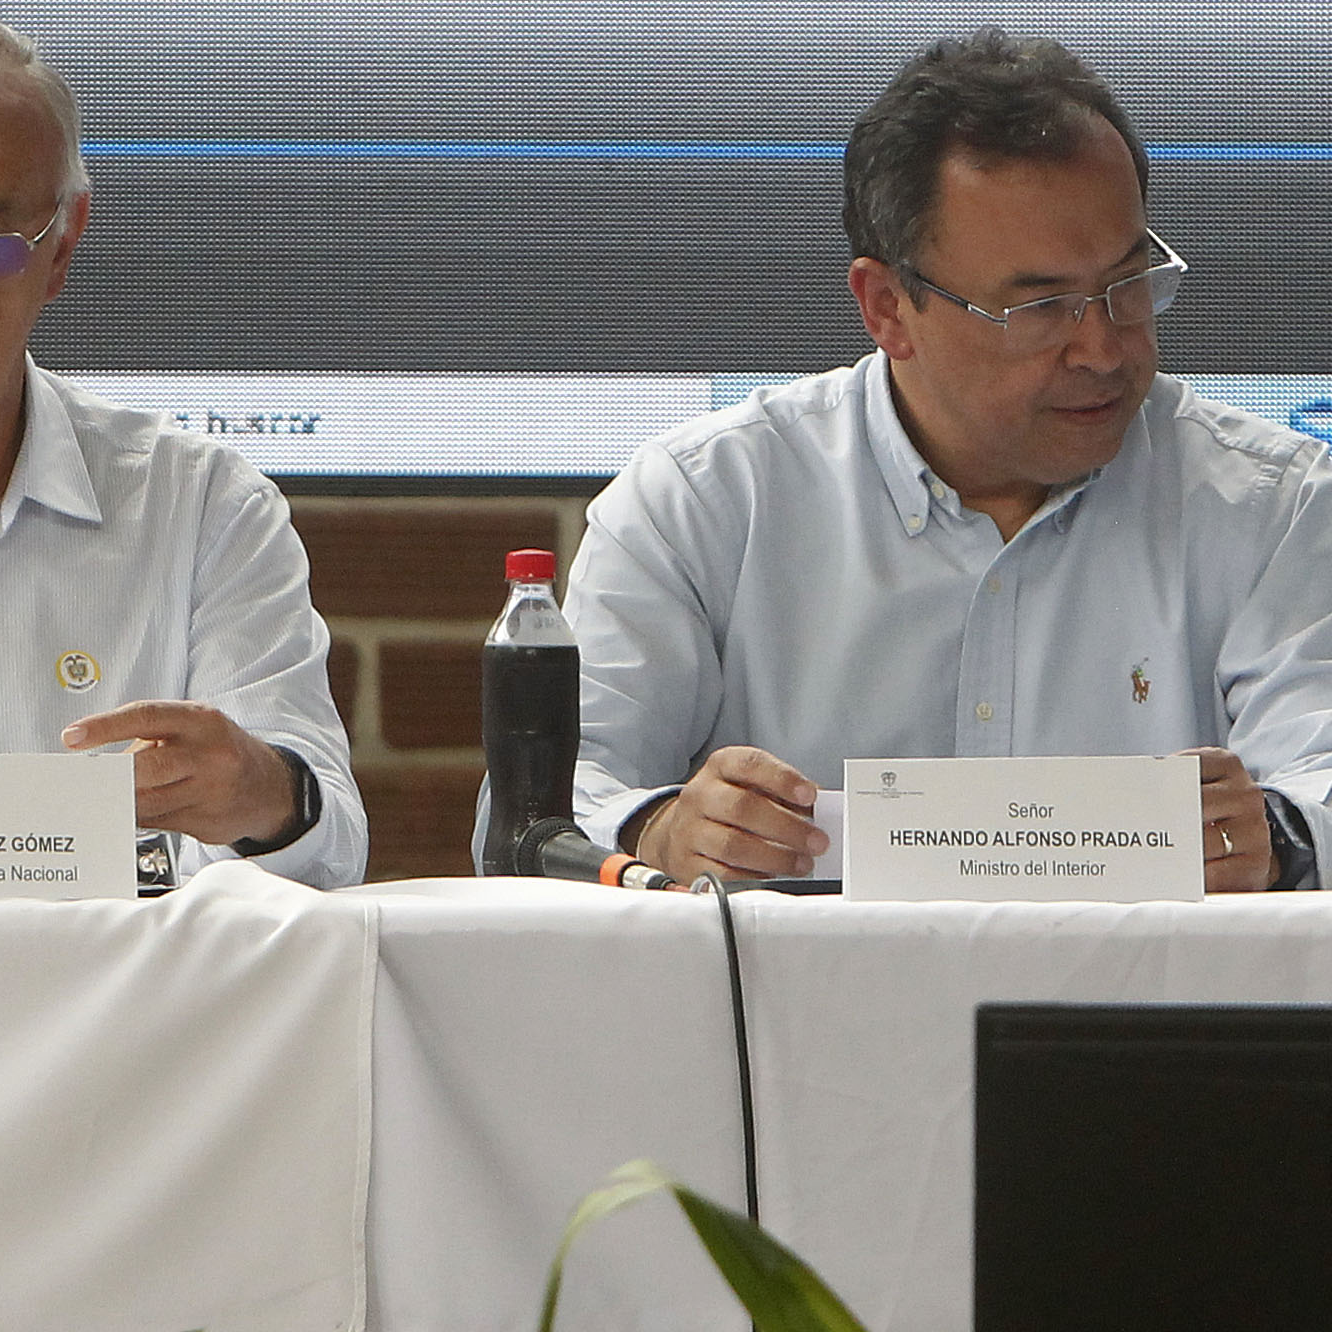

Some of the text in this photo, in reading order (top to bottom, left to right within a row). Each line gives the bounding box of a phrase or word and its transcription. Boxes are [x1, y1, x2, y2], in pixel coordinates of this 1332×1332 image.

[1008, 802, 1055, 818] Señor
[11, 833, 75, 853] GÓMEZ
[890, 830, 1174, 847] HERNANDO ALFONSO PRADA GIL
[11, 865, 79, 882] Nacional
[959, 859, 1106, 876] Ministro del Interior
